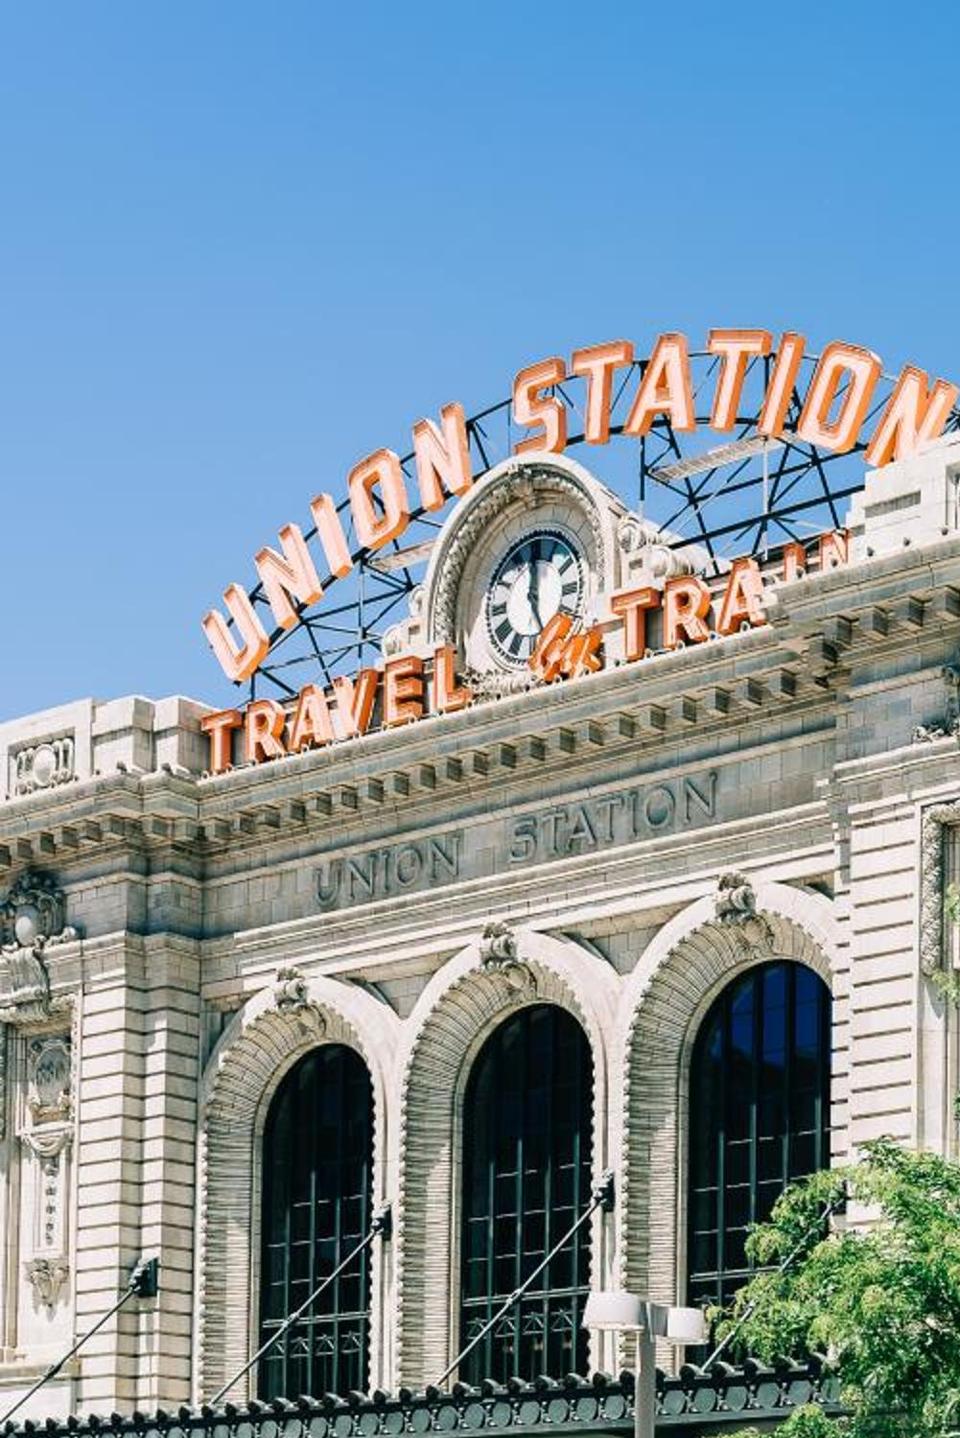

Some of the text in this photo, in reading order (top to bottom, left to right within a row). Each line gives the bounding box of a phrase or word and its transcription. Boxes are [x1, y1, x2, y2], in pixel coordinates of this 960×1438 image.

[202, 329, 960, 682] UNION STATION
[201, 641, 473, 773] TRAVEL
[611, 528, 853, 662] TRAIN
[313, 771, 719, 907] UNION STATION
